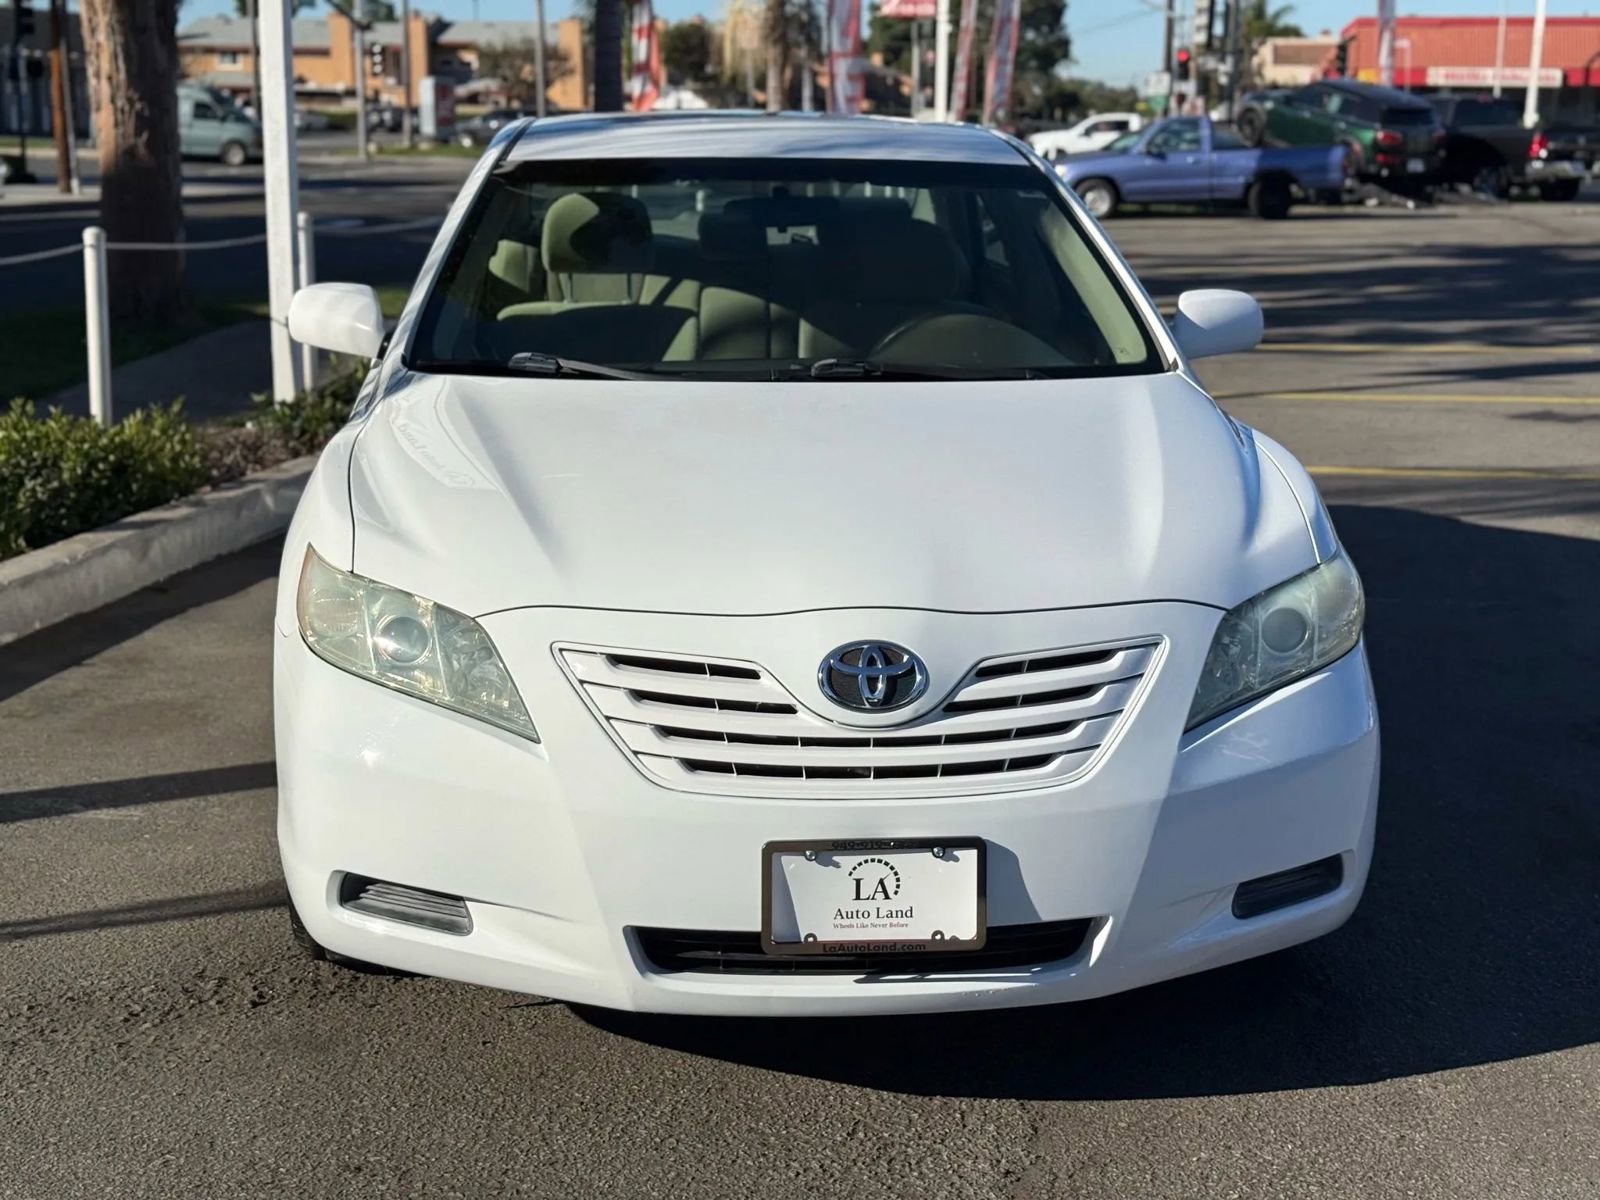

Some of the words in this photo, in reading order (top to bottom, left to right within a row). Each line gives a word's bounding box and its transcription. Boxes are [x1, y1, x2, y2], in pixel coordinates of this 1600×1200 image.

[852, 877, 892, 901] LA
[833, 907, 870, 920] Auto
[876, 906, 913, 919] Land
[822, 942, 926, 953] LaAutoLand.com
